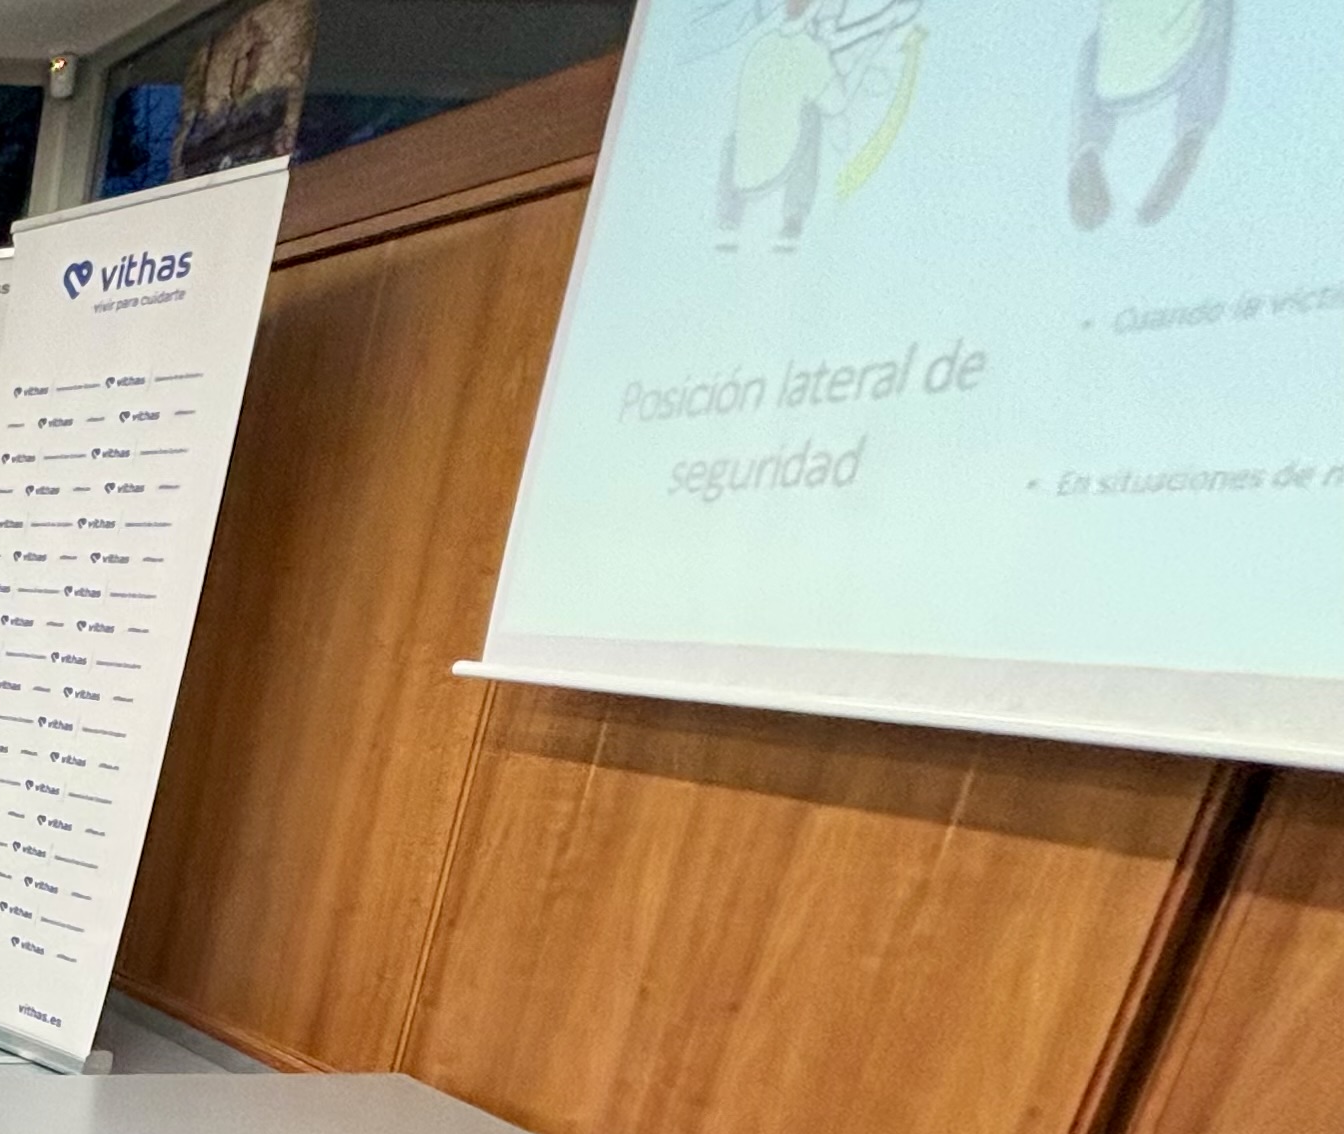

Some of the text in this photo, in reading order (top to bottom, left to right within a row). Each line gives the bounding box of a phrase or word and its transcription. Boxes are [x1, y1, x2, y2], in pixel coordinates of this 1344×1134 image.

[100, 249, 194, 293] vithas
[619, 336, 988, 423] Posición lateral de
[667, 432, 868, 503] seguridad
[18, 1004, 62, 1028] vithas.es
